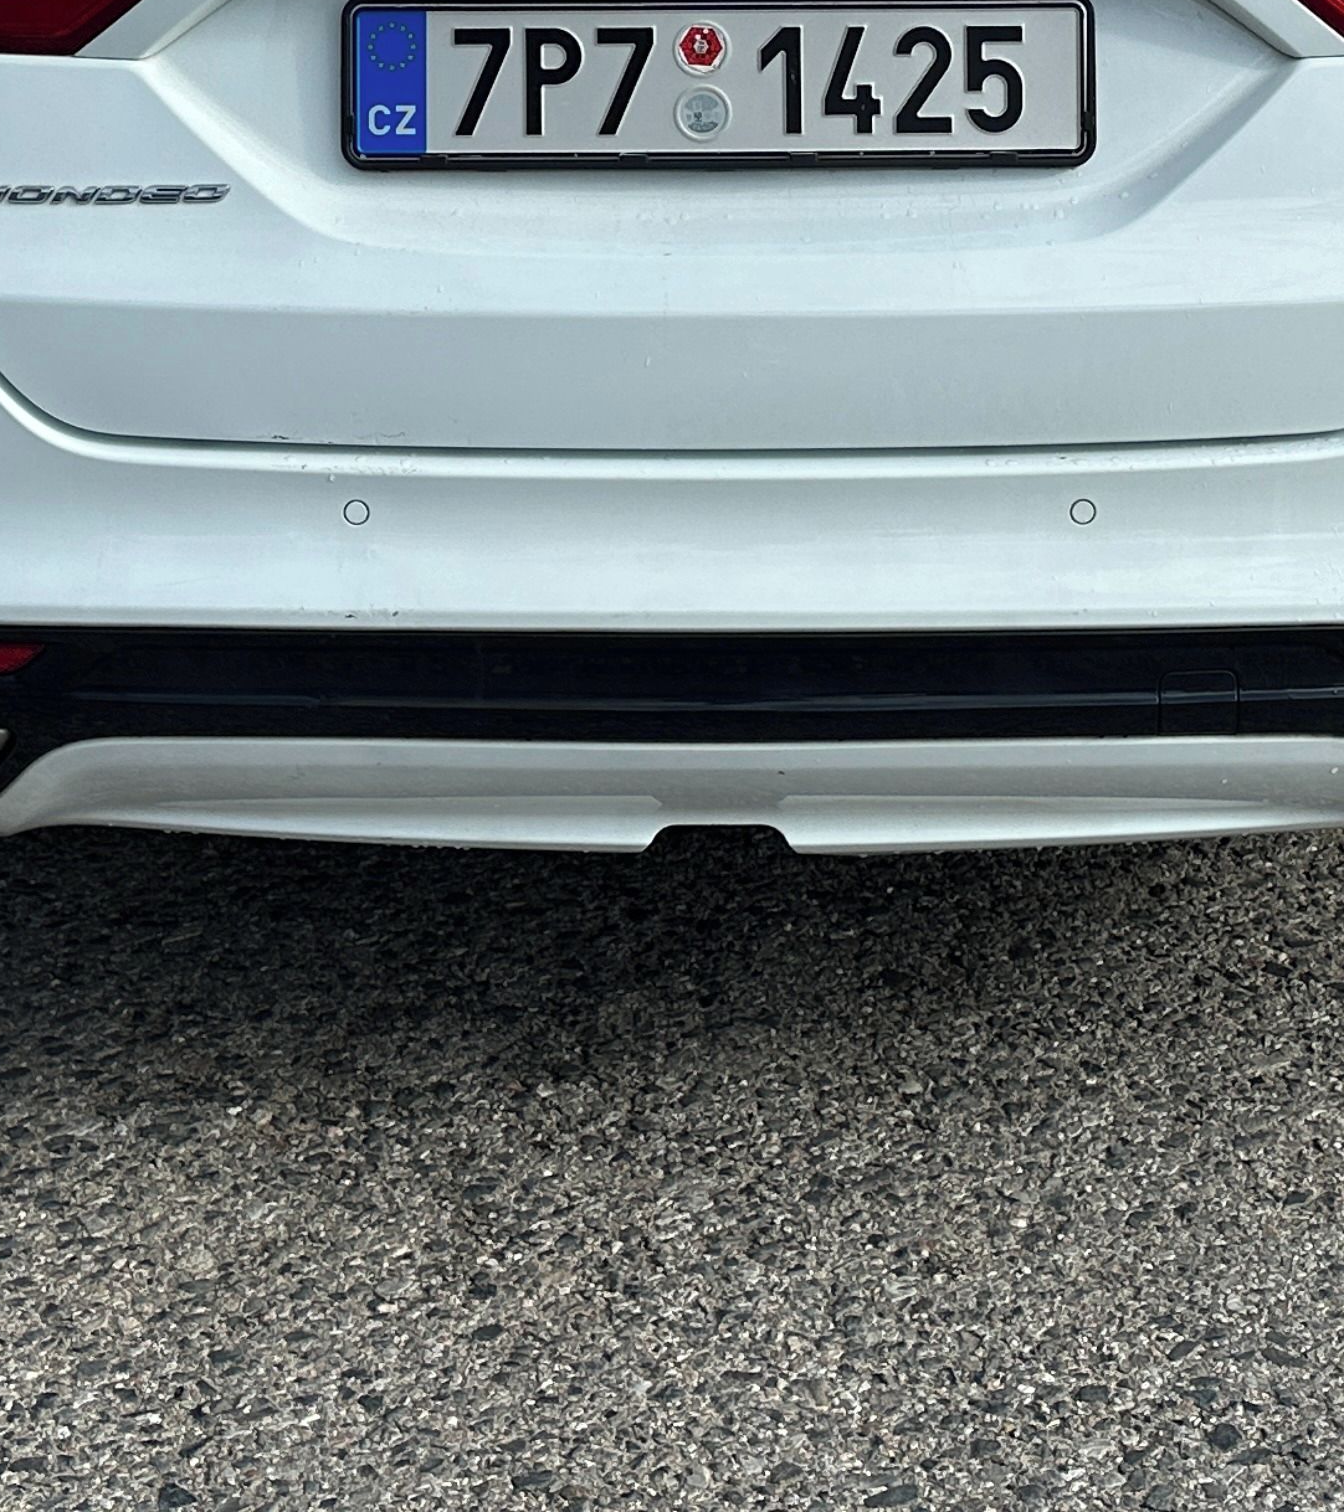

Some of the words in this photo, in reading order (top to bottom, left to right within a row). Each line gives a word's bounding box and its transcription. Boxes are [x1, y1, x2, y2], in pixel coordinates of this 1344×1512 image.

[367, 104, 417, 136] CZ
[453, 26, 656, 137] 7P7
[758, 25, 1026, 136] 1425
